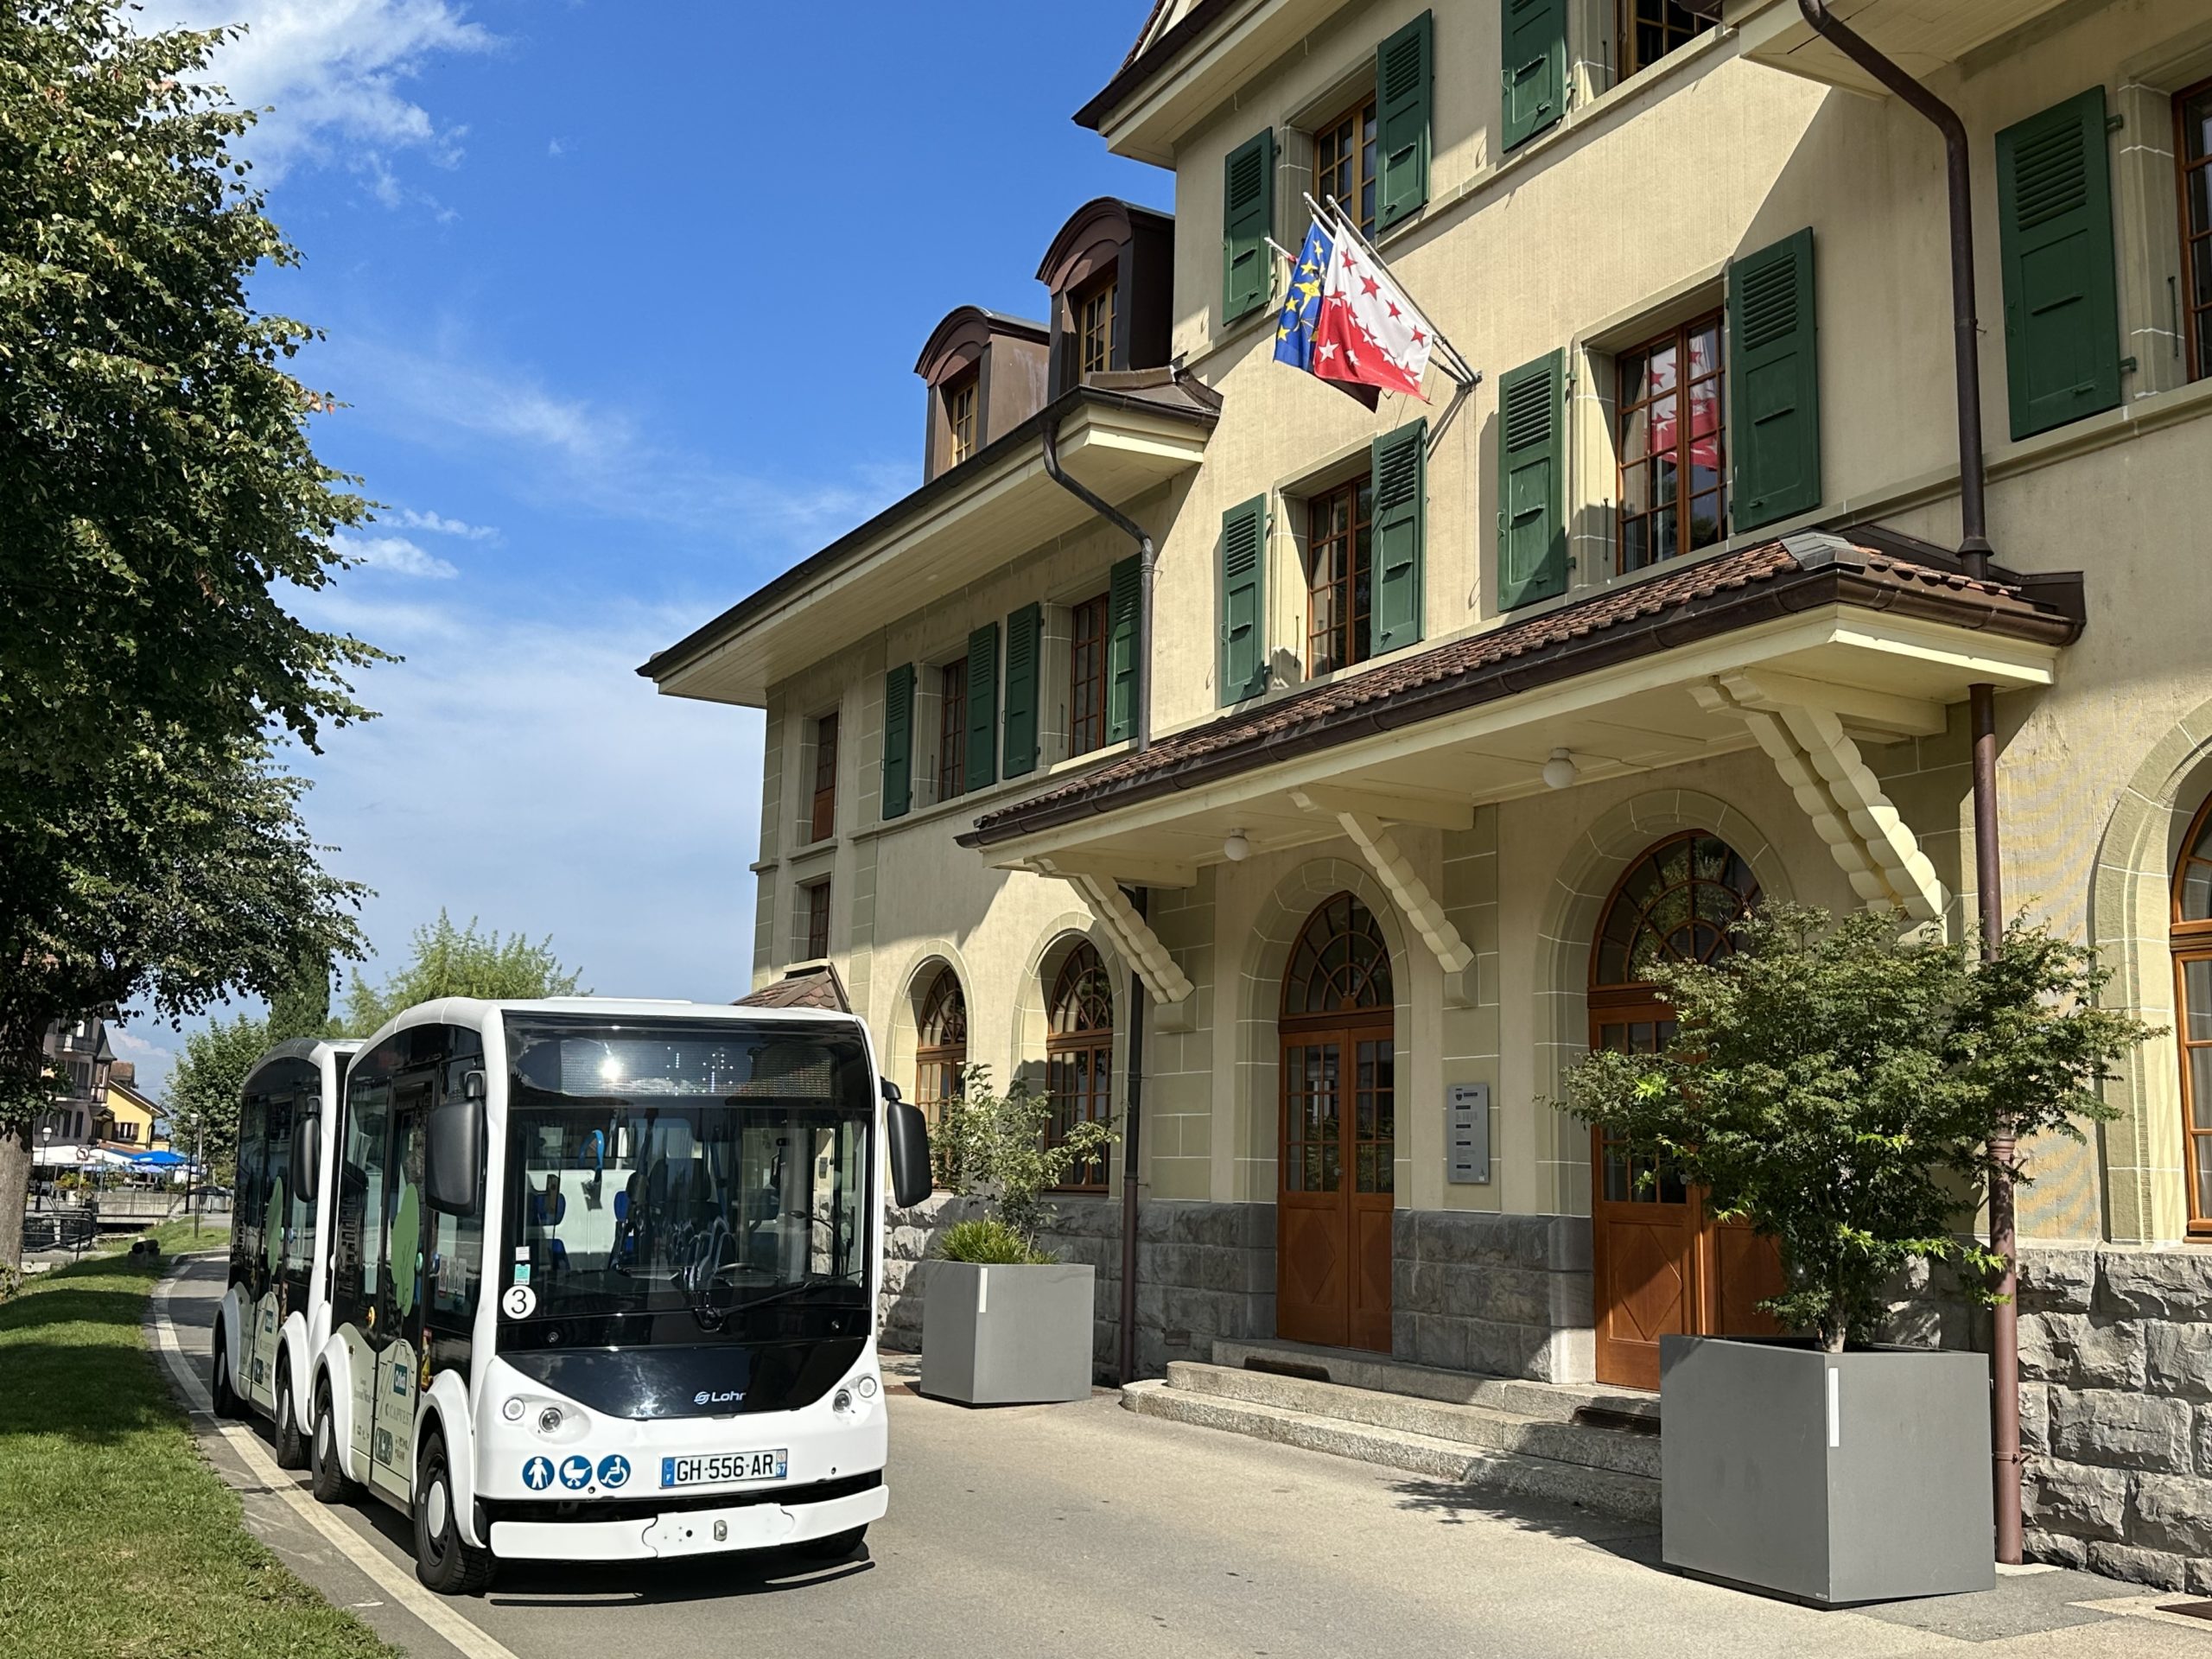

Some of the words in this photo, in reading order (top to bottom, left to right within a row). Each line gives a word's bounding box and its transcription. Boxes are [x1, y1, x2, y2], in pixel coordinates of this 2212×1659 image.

[511, 1288, 527, 1314] 3
[711, 1390, 747, 1402] Lohr
[677, 1453, 773, 1482] GH-556-AR
[776, 1463, 786, 1475] 67
